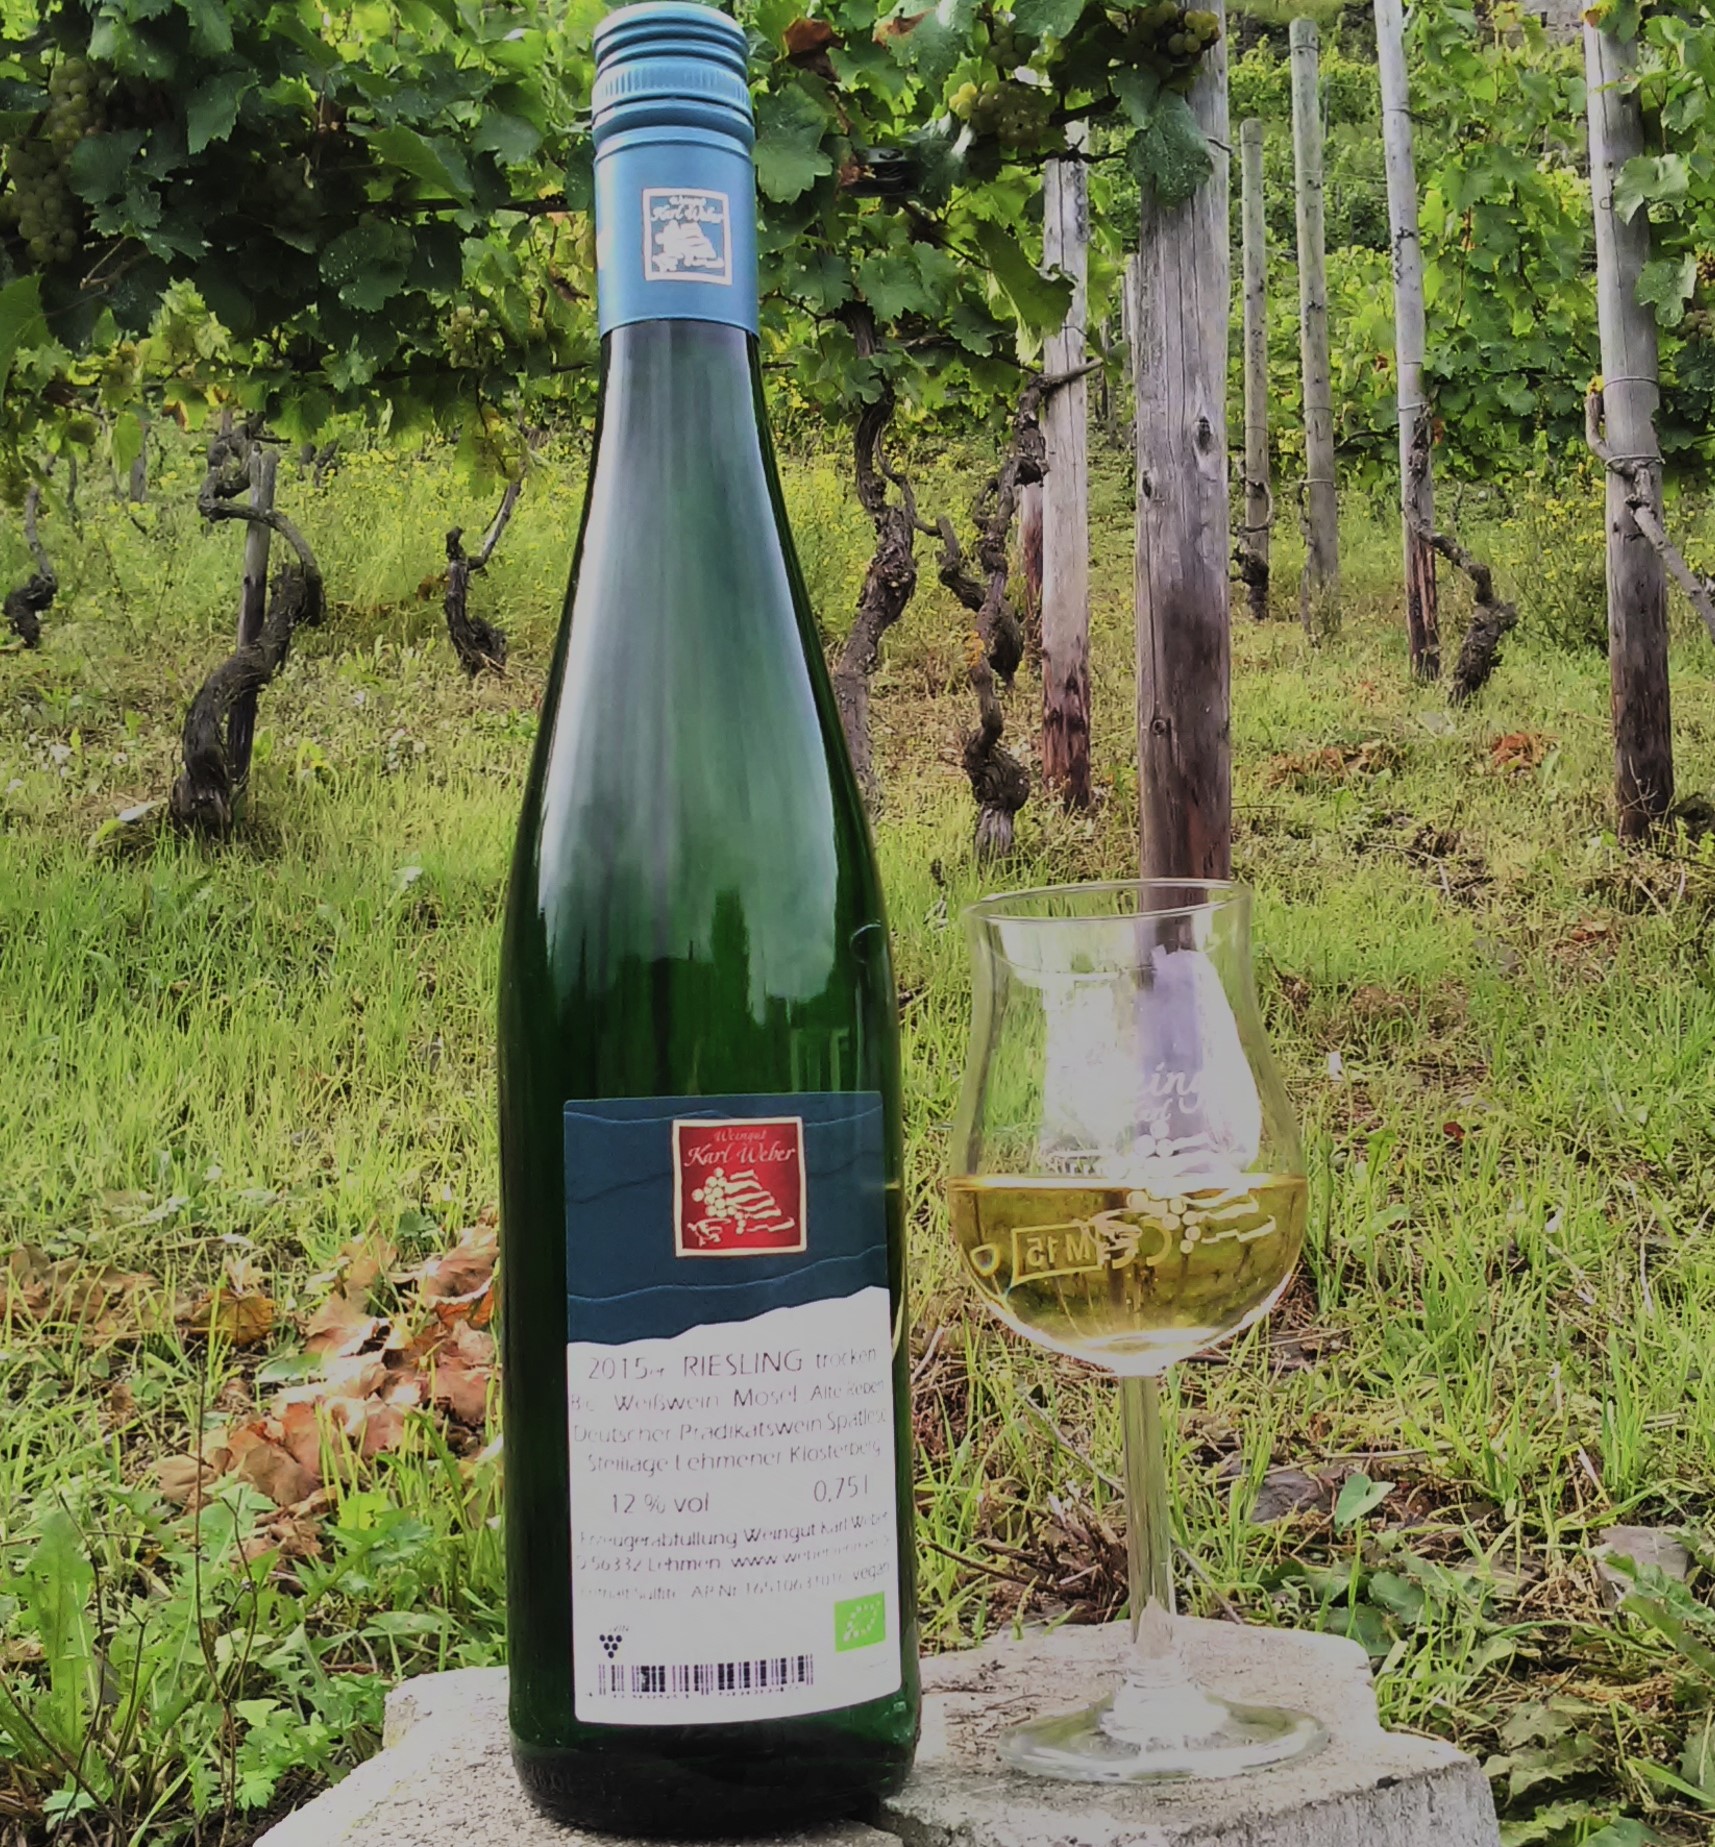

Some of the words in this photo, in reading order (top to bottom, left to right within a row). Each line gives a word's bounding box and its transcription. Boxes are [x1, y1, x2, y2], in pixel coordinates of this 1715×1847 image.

[713, 1127, 767, 1143] Weingut
[684, 1142, 735, 1167] Karl
[736, 1140, 796, 1163] Weber
[684, 1348, 803, 1377] RIESLING
[816, 1347, 877, 1369] trocken
[614, 1393, 719, 1412] Weißwein
[733, 1385, 797, 1407] Mosel
[810, 1384, 842, 1401] Alte
[573, 1424, 671, 1443] Deutscher
[588, 1453, 669, 1477] Steillage
[675, 1450, 781, 1471] Lehmener
[790, 1438, 881, 1464] Klosterberg
[612, 1493, 636, 1513] 12
[644, 1493, 666, 1514] %
[674, 1491, 709, 1513] vol
[743, 1522, 816, 1544] Weingut
[648, 1556, 721, 1573] Lehmen
[852, 1561, 890, 1581] vegan
